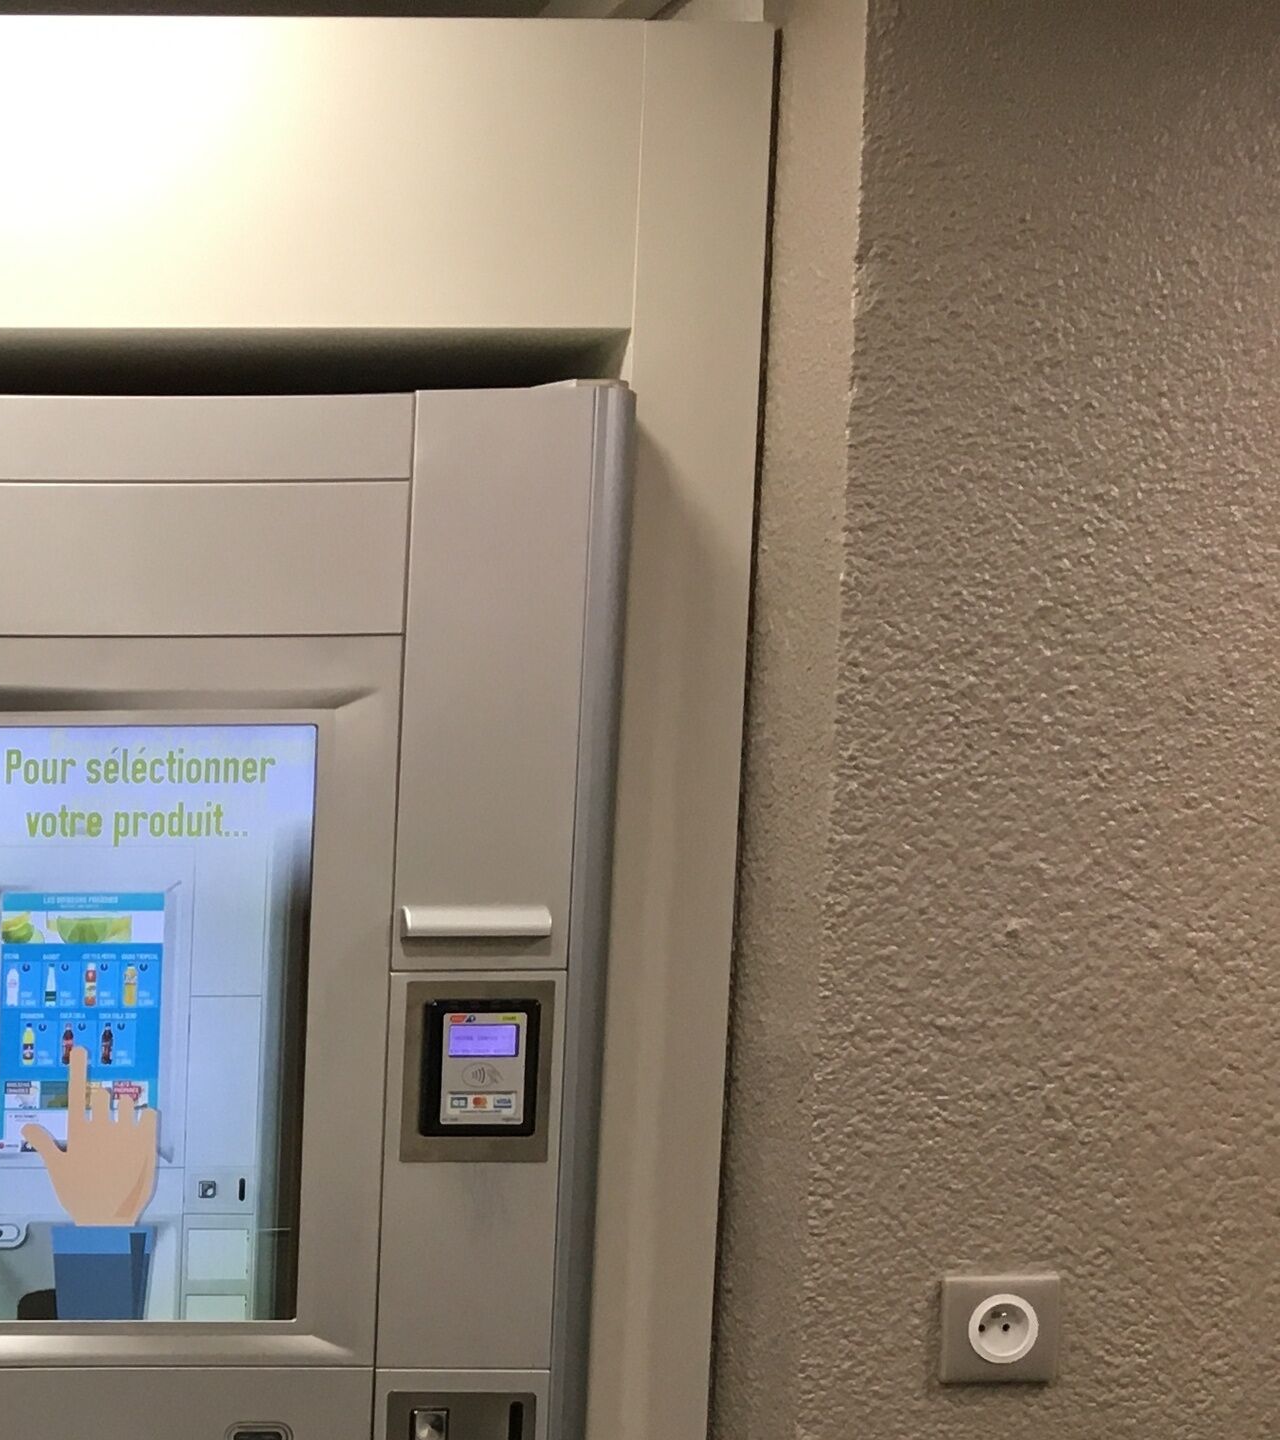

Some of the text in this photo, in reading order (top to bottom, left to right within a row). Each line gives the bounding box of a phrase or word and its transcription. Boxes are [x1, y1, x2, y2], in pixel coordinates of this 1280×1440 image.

[5, 746, 277, 785] Pour séléctionner
[25, 804, 103, 838] votre
